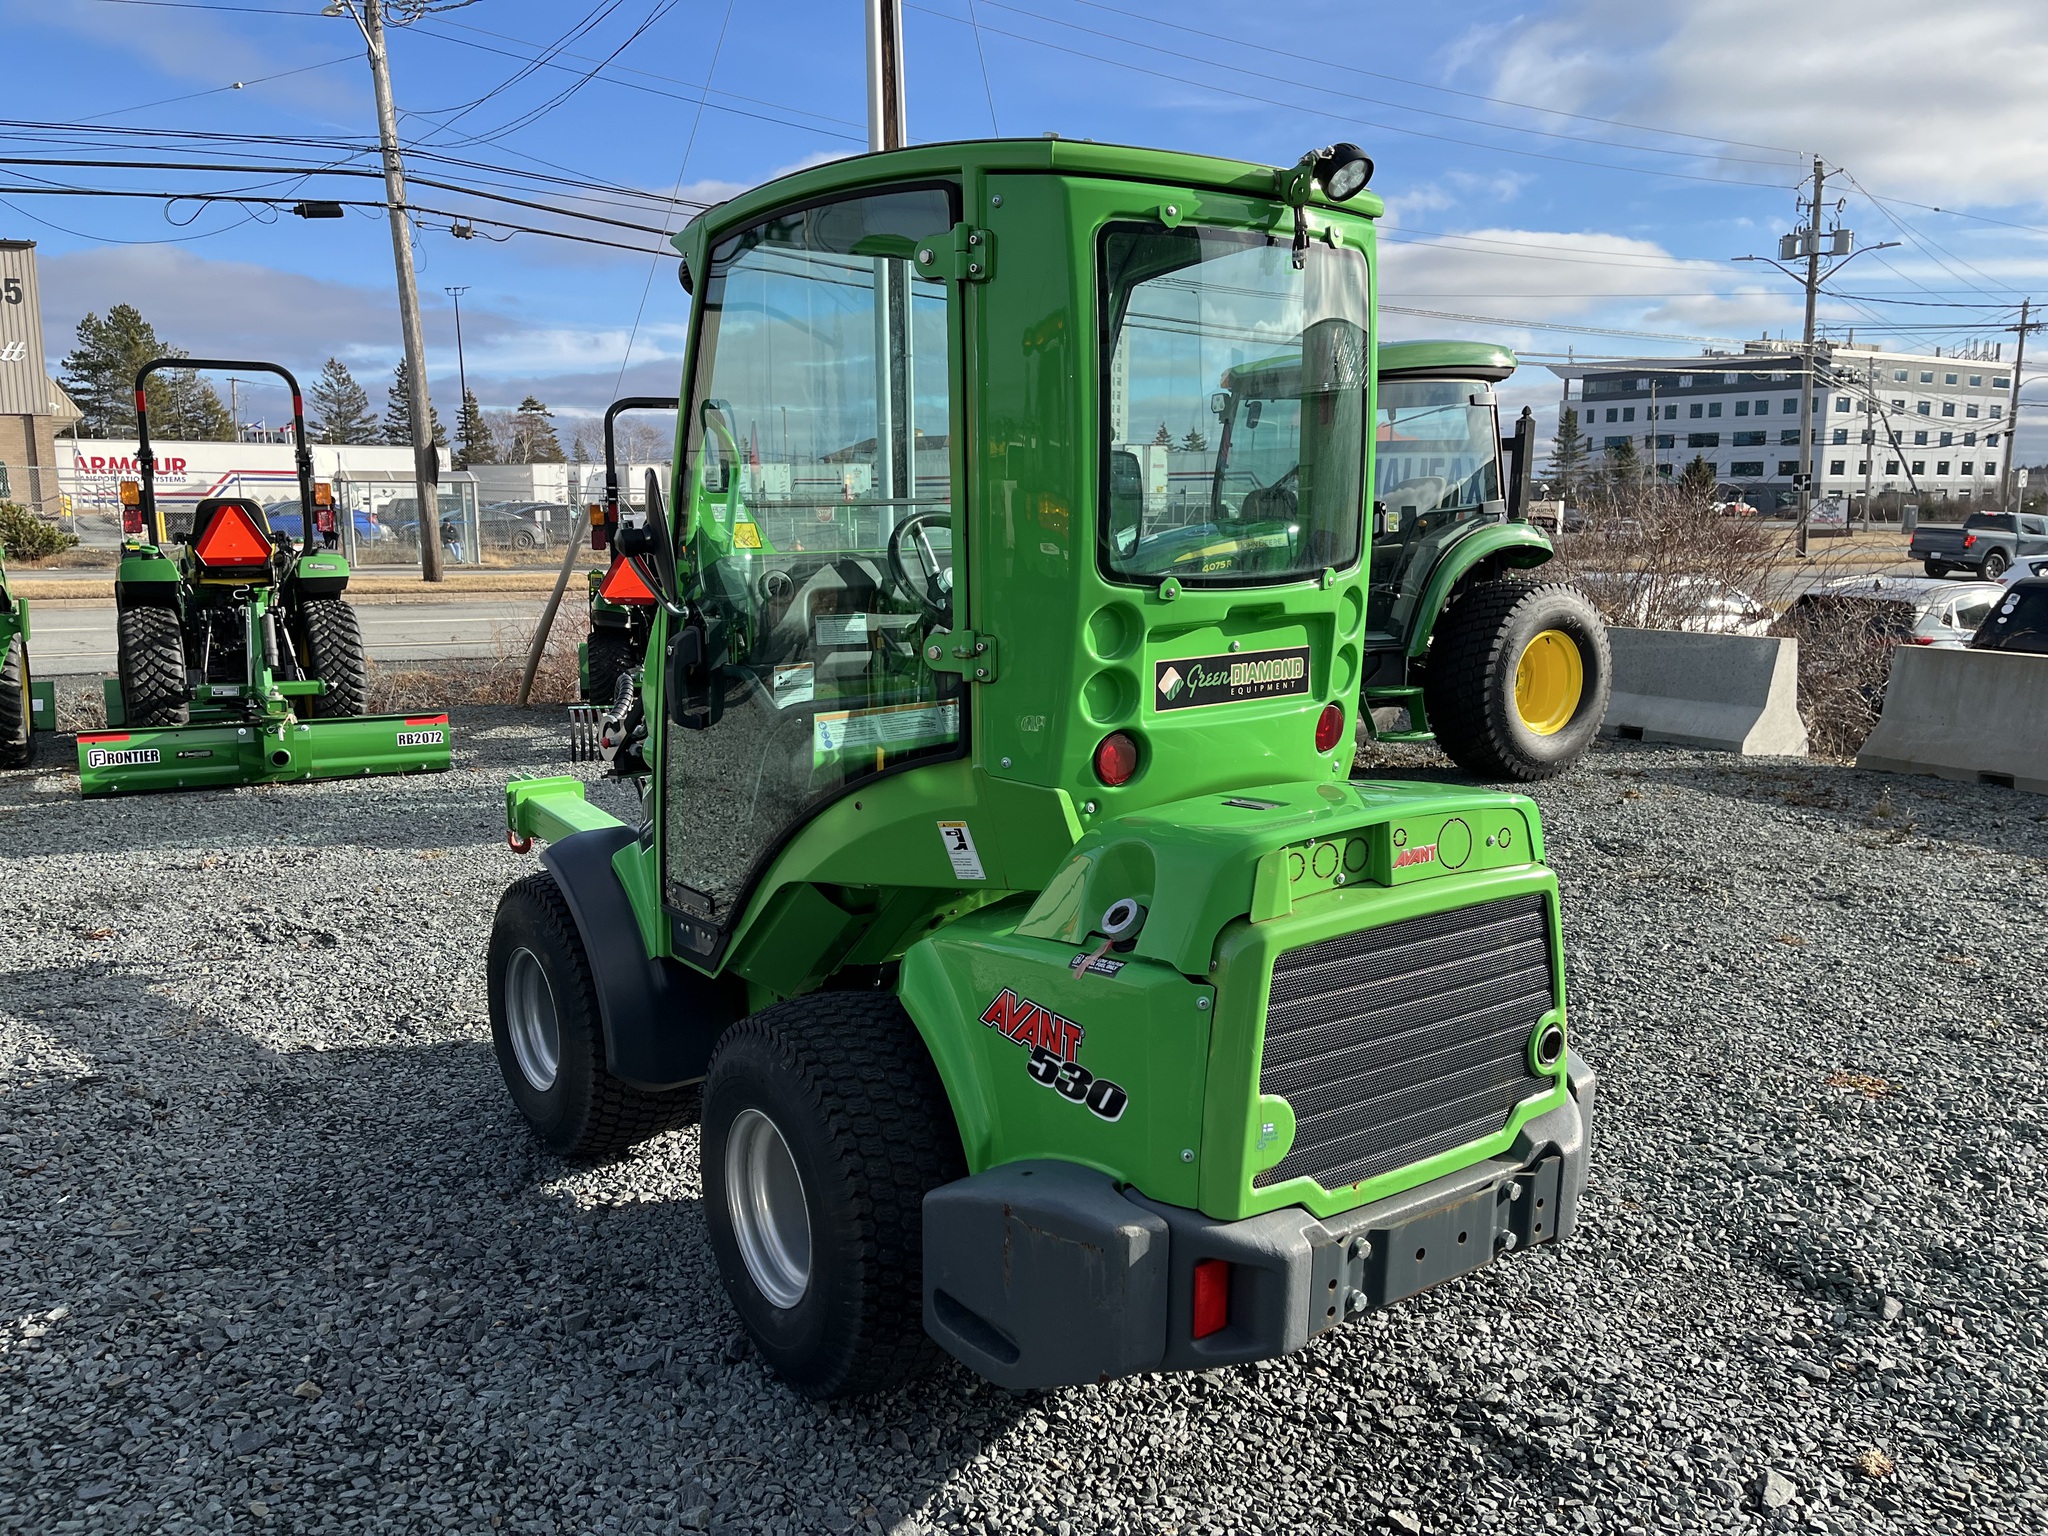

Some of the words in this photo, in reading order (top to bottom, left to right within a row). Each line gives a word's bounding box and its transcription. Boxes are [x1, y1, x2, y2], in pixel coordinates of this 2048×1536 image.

[0, 277, 23, 305] 5
[152, 475, 187, 483] YSTEMS
[817, 509, 832, 517] STOP
[1202, 560, 1232, 573] 4075R
[1186, 663, 1232, 698] Green
[1230, 656, 1305, 685] DIAMOND
[1230, 680, 1296, 696] EQUIPMENT
[397, 731, 444, 746] RB2072
[88, 749, 161, 768] FRONTIER
[1392, 844, 1437, 869] AVANT
[978, 986, 1085, 1063] AVANT
[1026, 1044, 1129, 1123] 530
